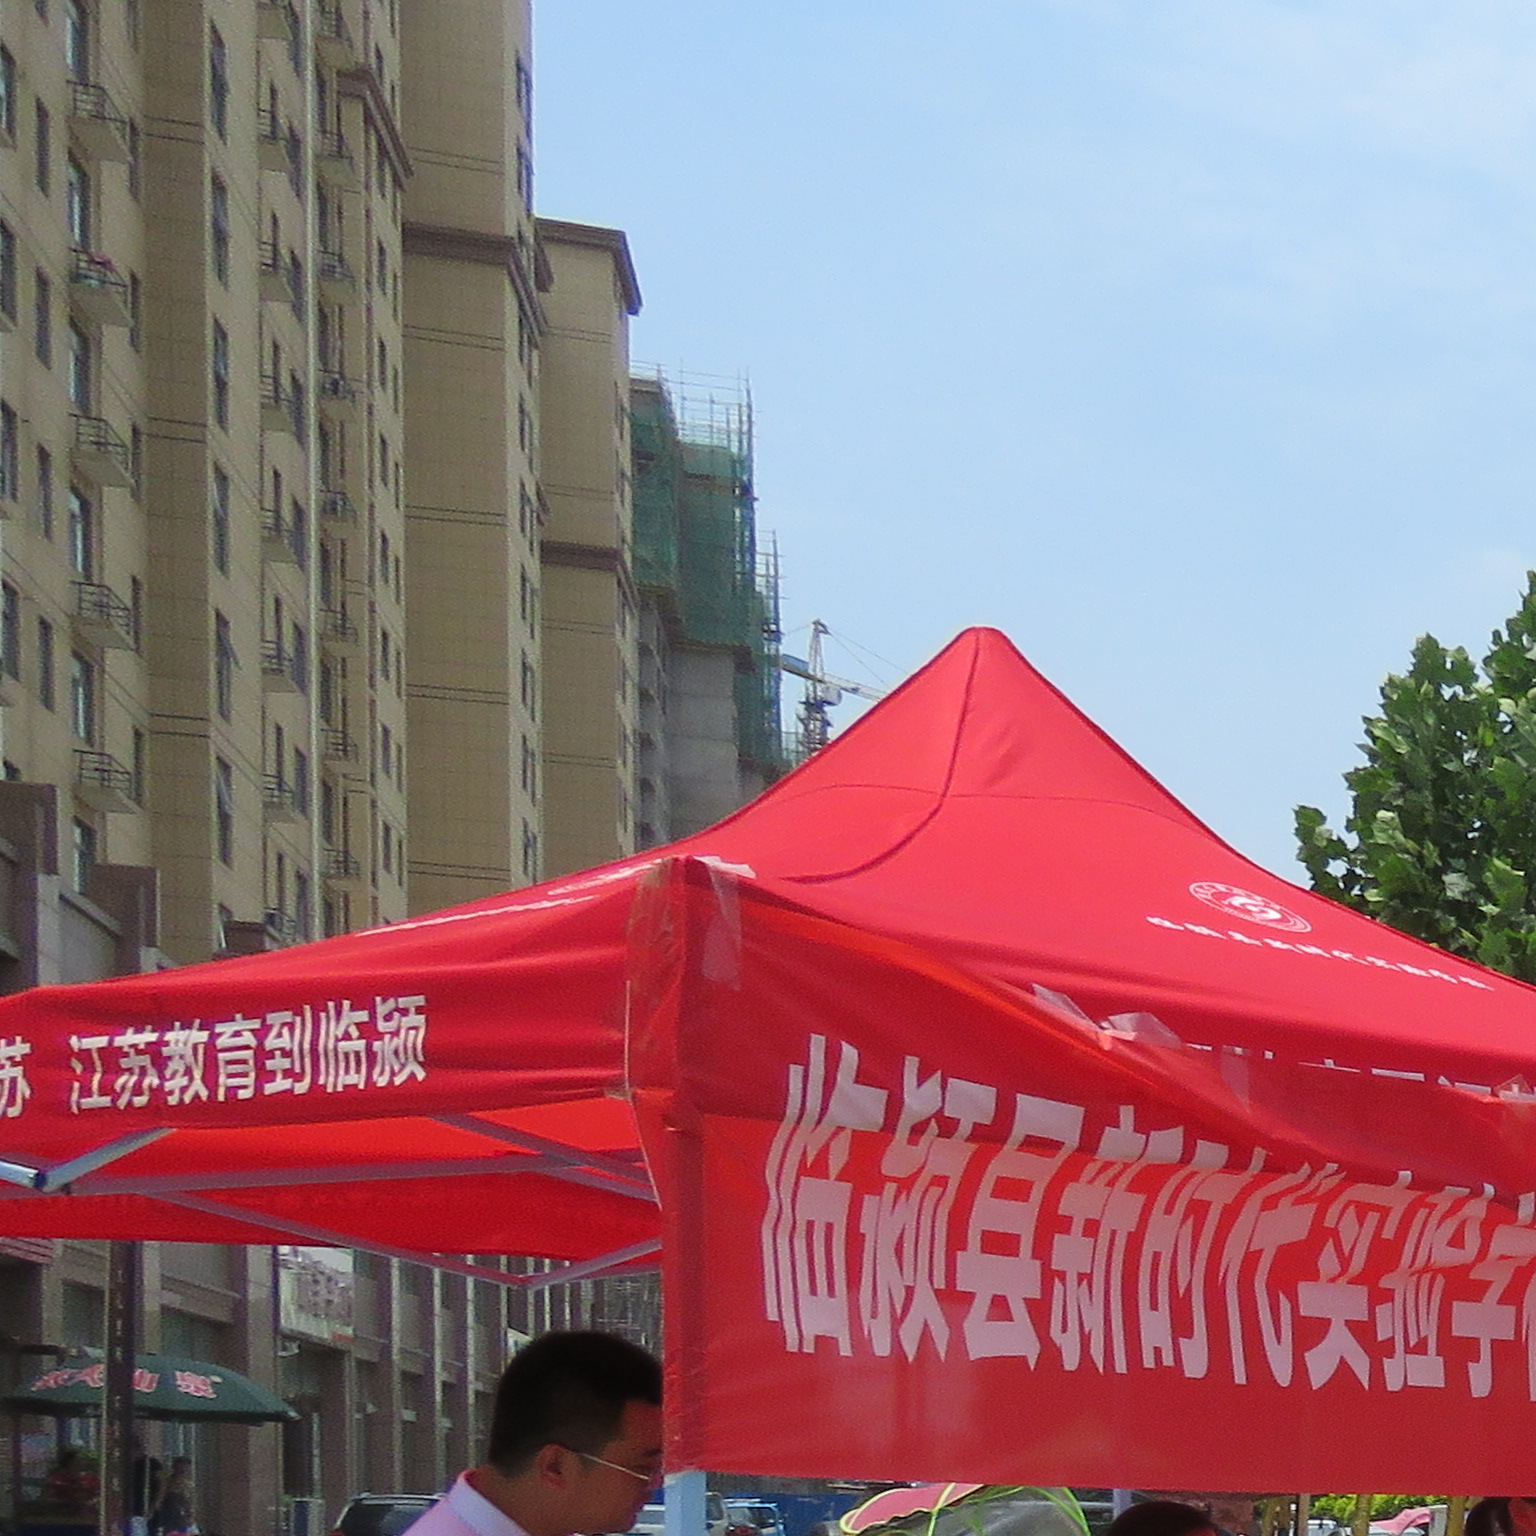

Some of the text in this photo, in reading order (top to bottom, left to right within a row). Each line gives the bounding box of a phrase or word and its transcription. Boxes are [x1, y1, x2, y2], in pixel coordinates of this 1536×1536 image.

[69, 995, 426, 1114] 江苏教育到临颍
